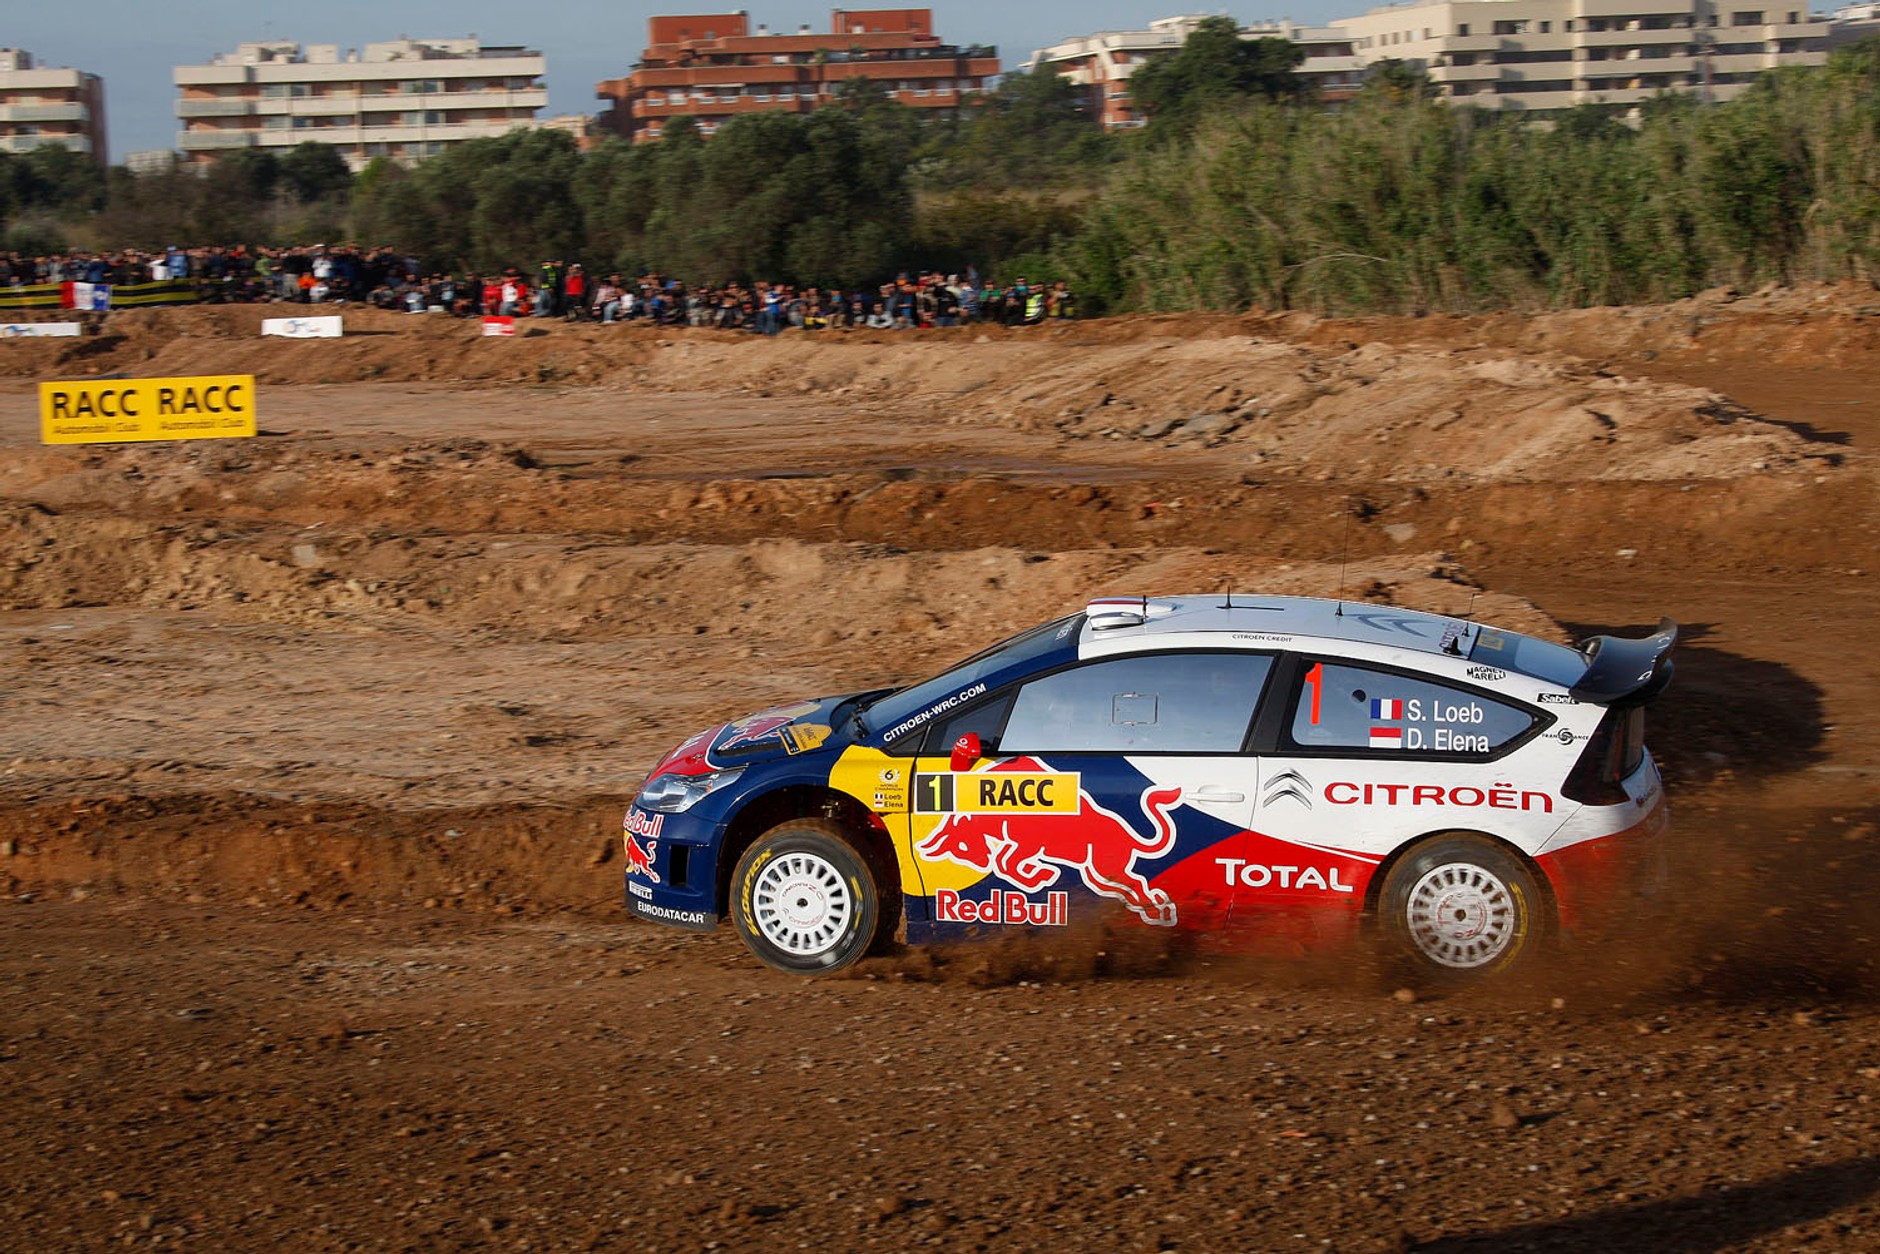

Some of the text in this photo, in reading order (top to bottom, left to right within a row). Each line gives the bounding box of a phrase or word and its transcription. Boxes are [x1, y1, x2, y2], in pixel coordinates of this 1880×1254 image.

[52, 384, 244, 419] RACC RACC
[1304, 662, 1323, 725] 1
[883, 683, 987, 742] CITROEN-WRC.COM
[1407, 699, 1483, 724] S. Loeb
[1407, 728, 1489, 753] D. Elena
[885, 769, 894, 780] 6
[884, 793, 902, 801] Loeb
[928, 775, 941, 811] 1
[979, 779, 1054, 807] RACC
[635, 810, 664, 838] Bull
[1214, 858, 1354, 892] TOTAL
[637, 901, 706, 924] EURODATACAR
[936, 888, 1068, 926] Red Bull
